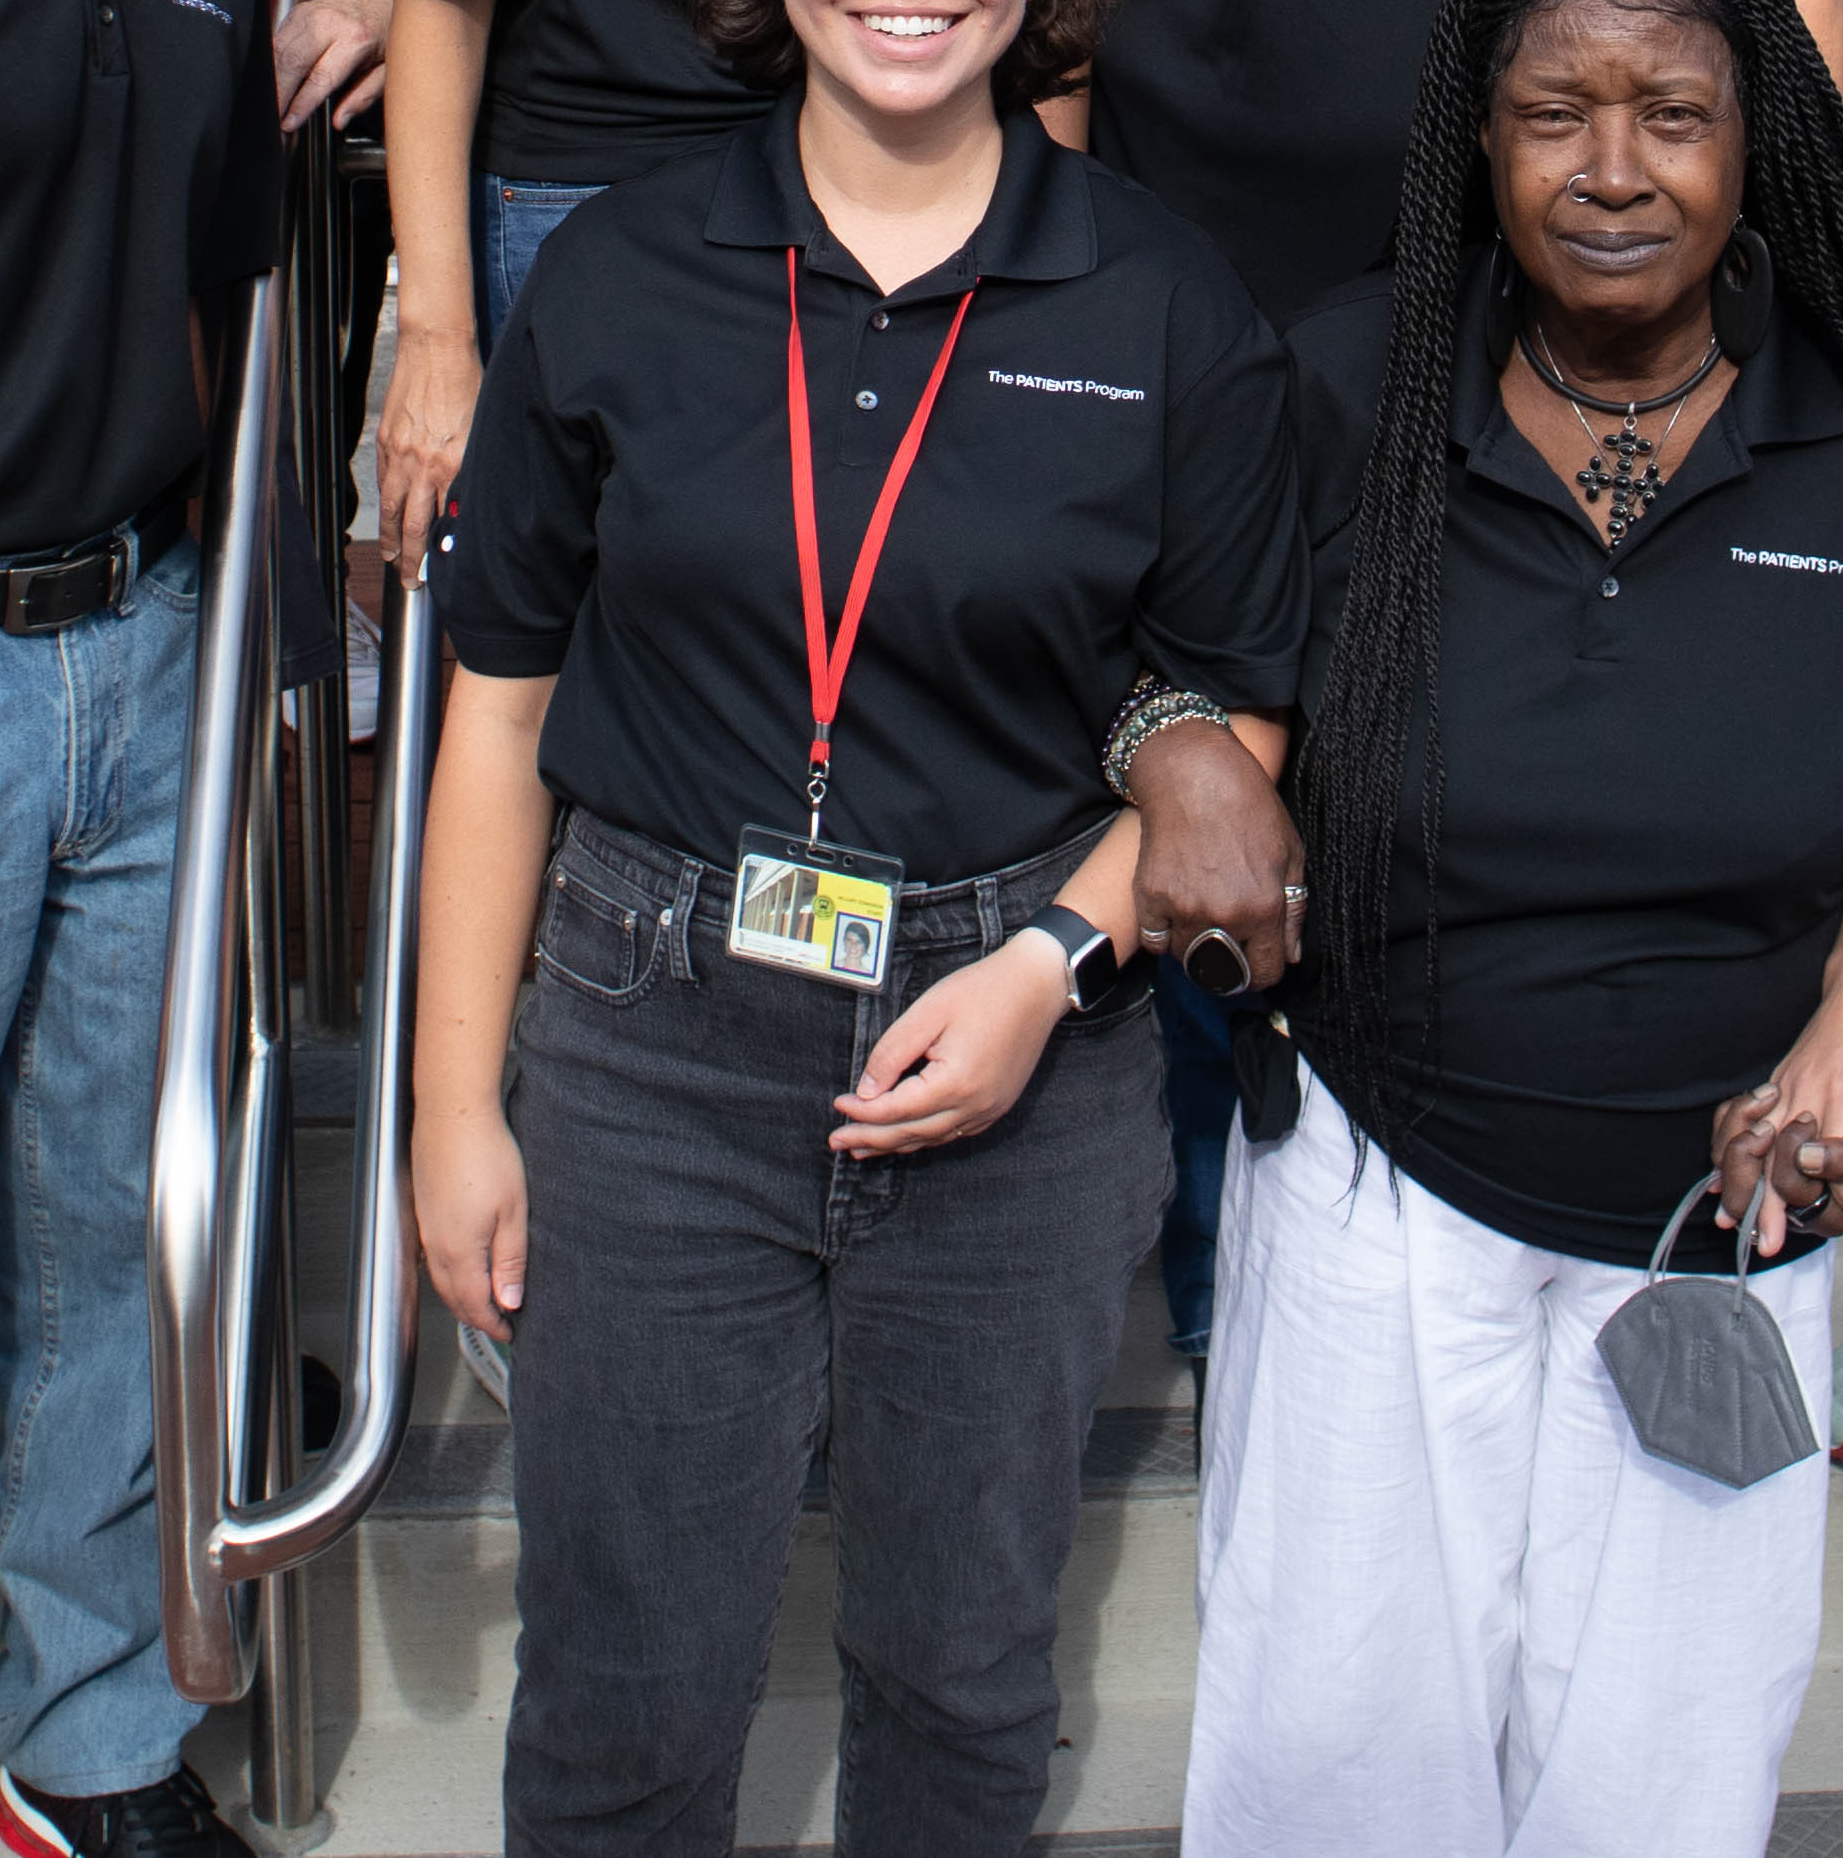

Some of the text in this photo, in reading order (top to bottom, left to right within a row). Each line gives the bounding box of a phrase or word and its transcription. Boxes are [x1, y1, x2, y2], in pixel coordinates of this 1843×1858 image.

[988, 370, 1145, 401] The PATIENTS Program
[1731, 547, 1757, 563] The
[1759, 550, 1827, 573] PATIENTS
